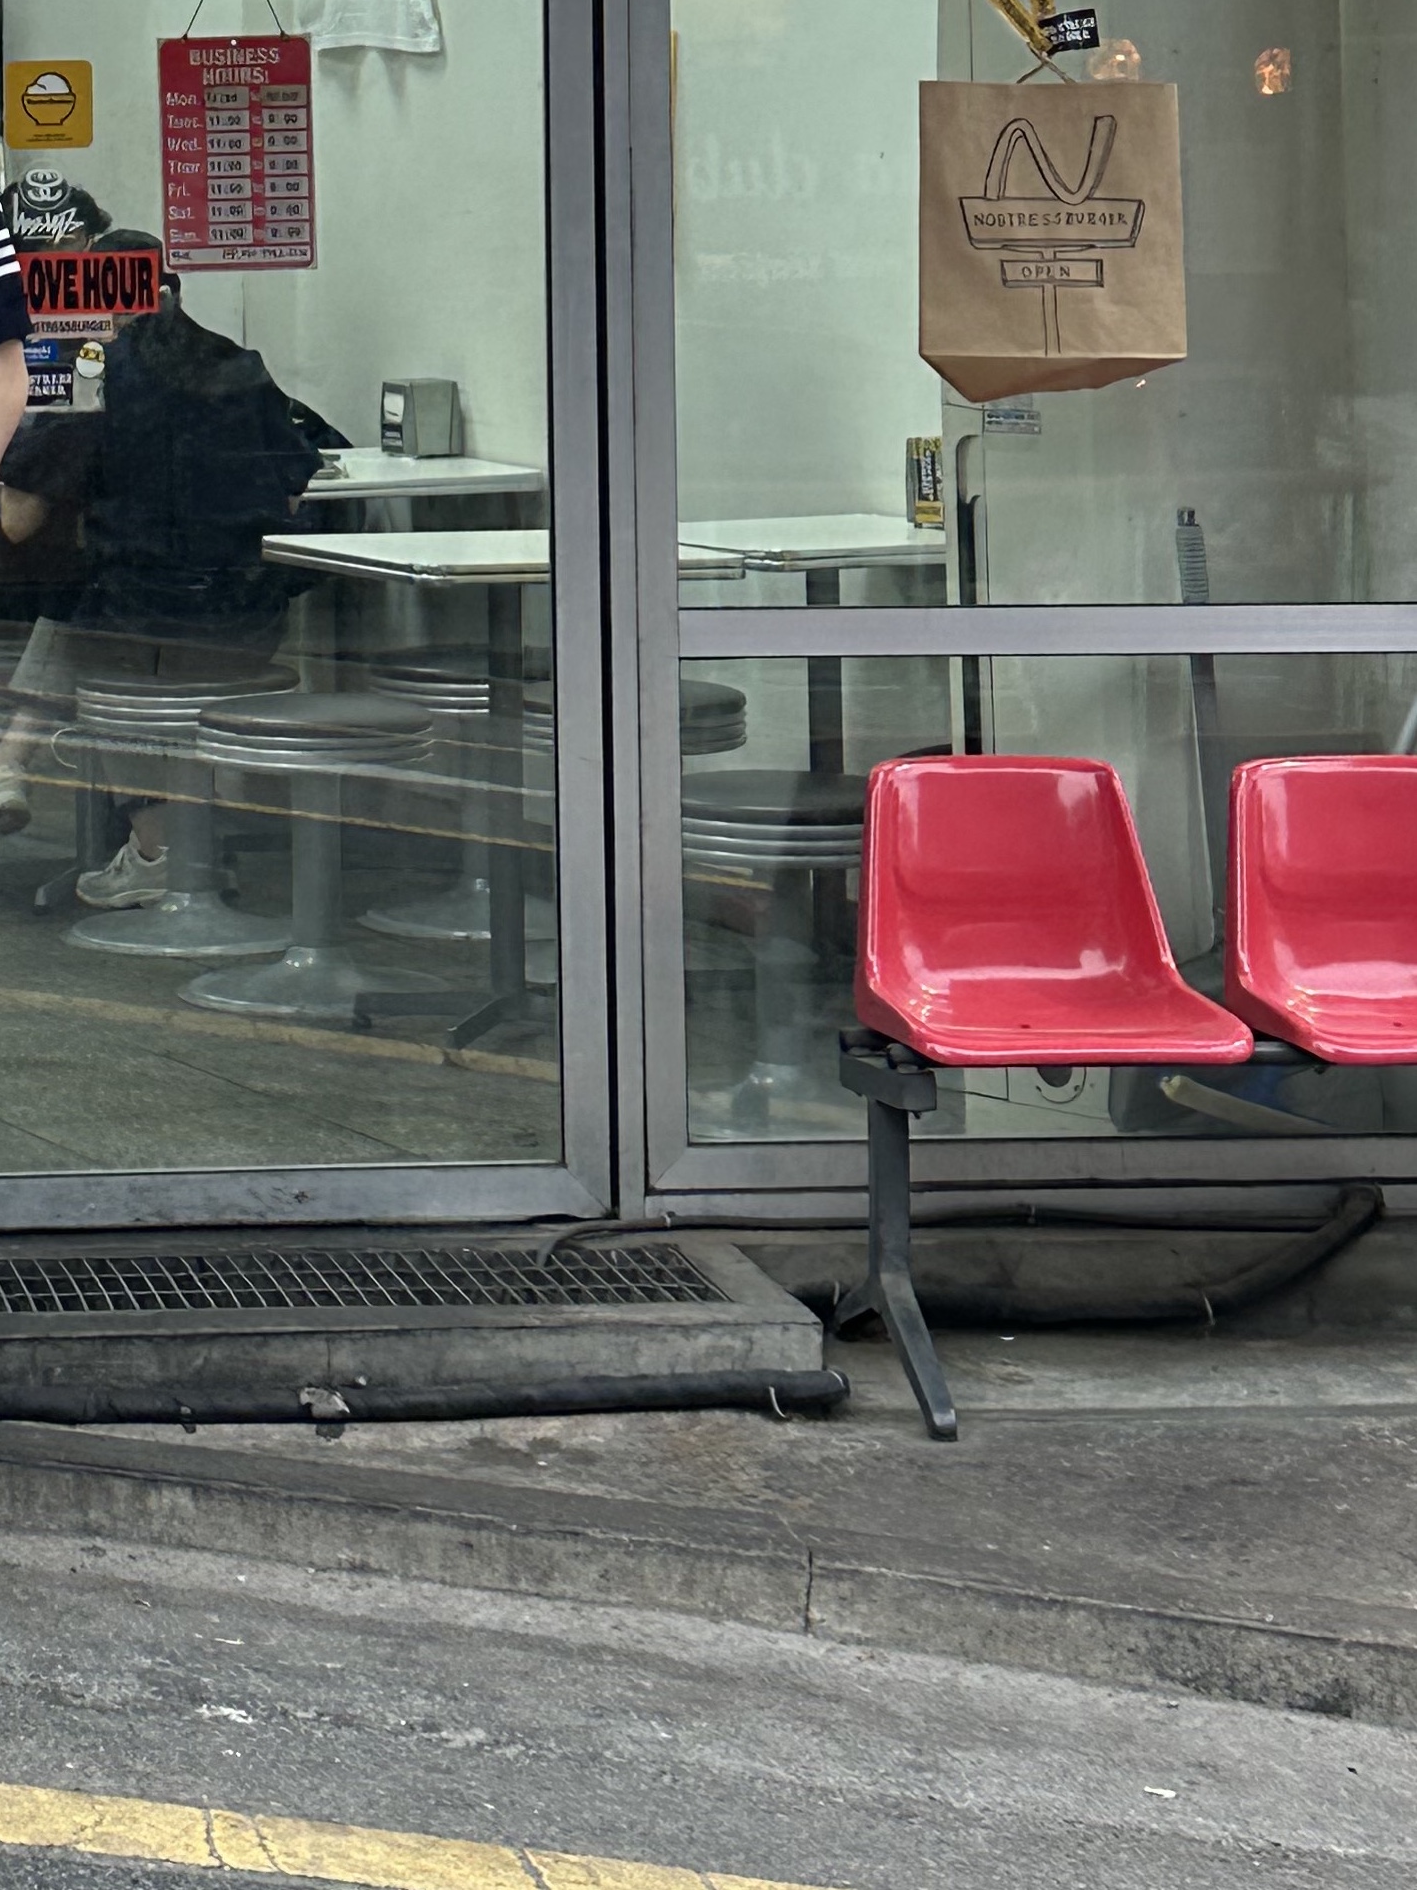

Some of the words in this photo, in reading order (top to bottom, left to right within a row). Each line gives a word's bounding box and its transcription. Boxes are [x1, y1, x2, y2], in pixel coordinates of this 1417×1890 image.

[189, 47, 281, 66] BUSINESS
[23, 257, 79, 311] OVE
[82, 256, 155, 310] HOUR
